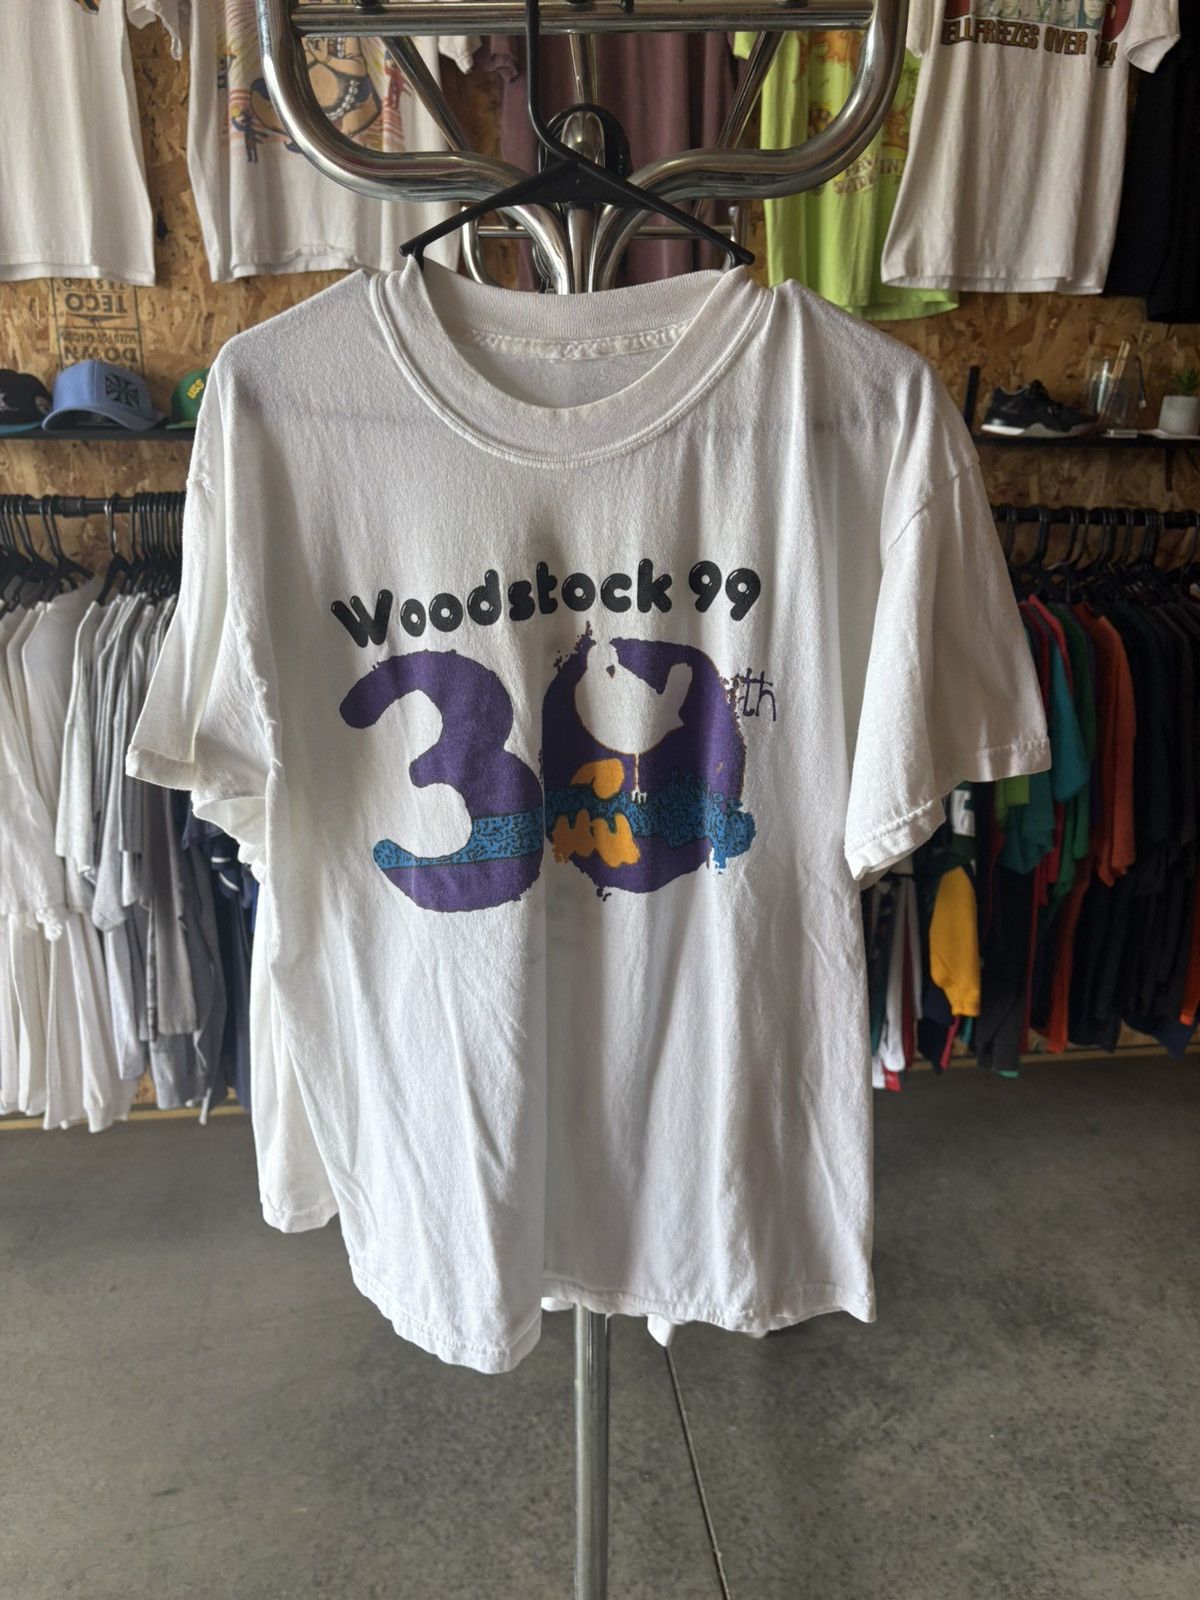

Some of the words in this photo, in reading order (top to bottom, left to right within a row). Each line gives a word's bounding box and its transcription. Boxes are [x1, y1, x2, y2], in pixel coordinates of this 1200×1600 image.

[974, 18, 1039, 49] FREEZES
[1044, 27, 1088, 55] OVER
[65, 294, 128, 313] TECO
[330, 558, 673, 648] Woodstock
[688, 560, 761, 622] 99
